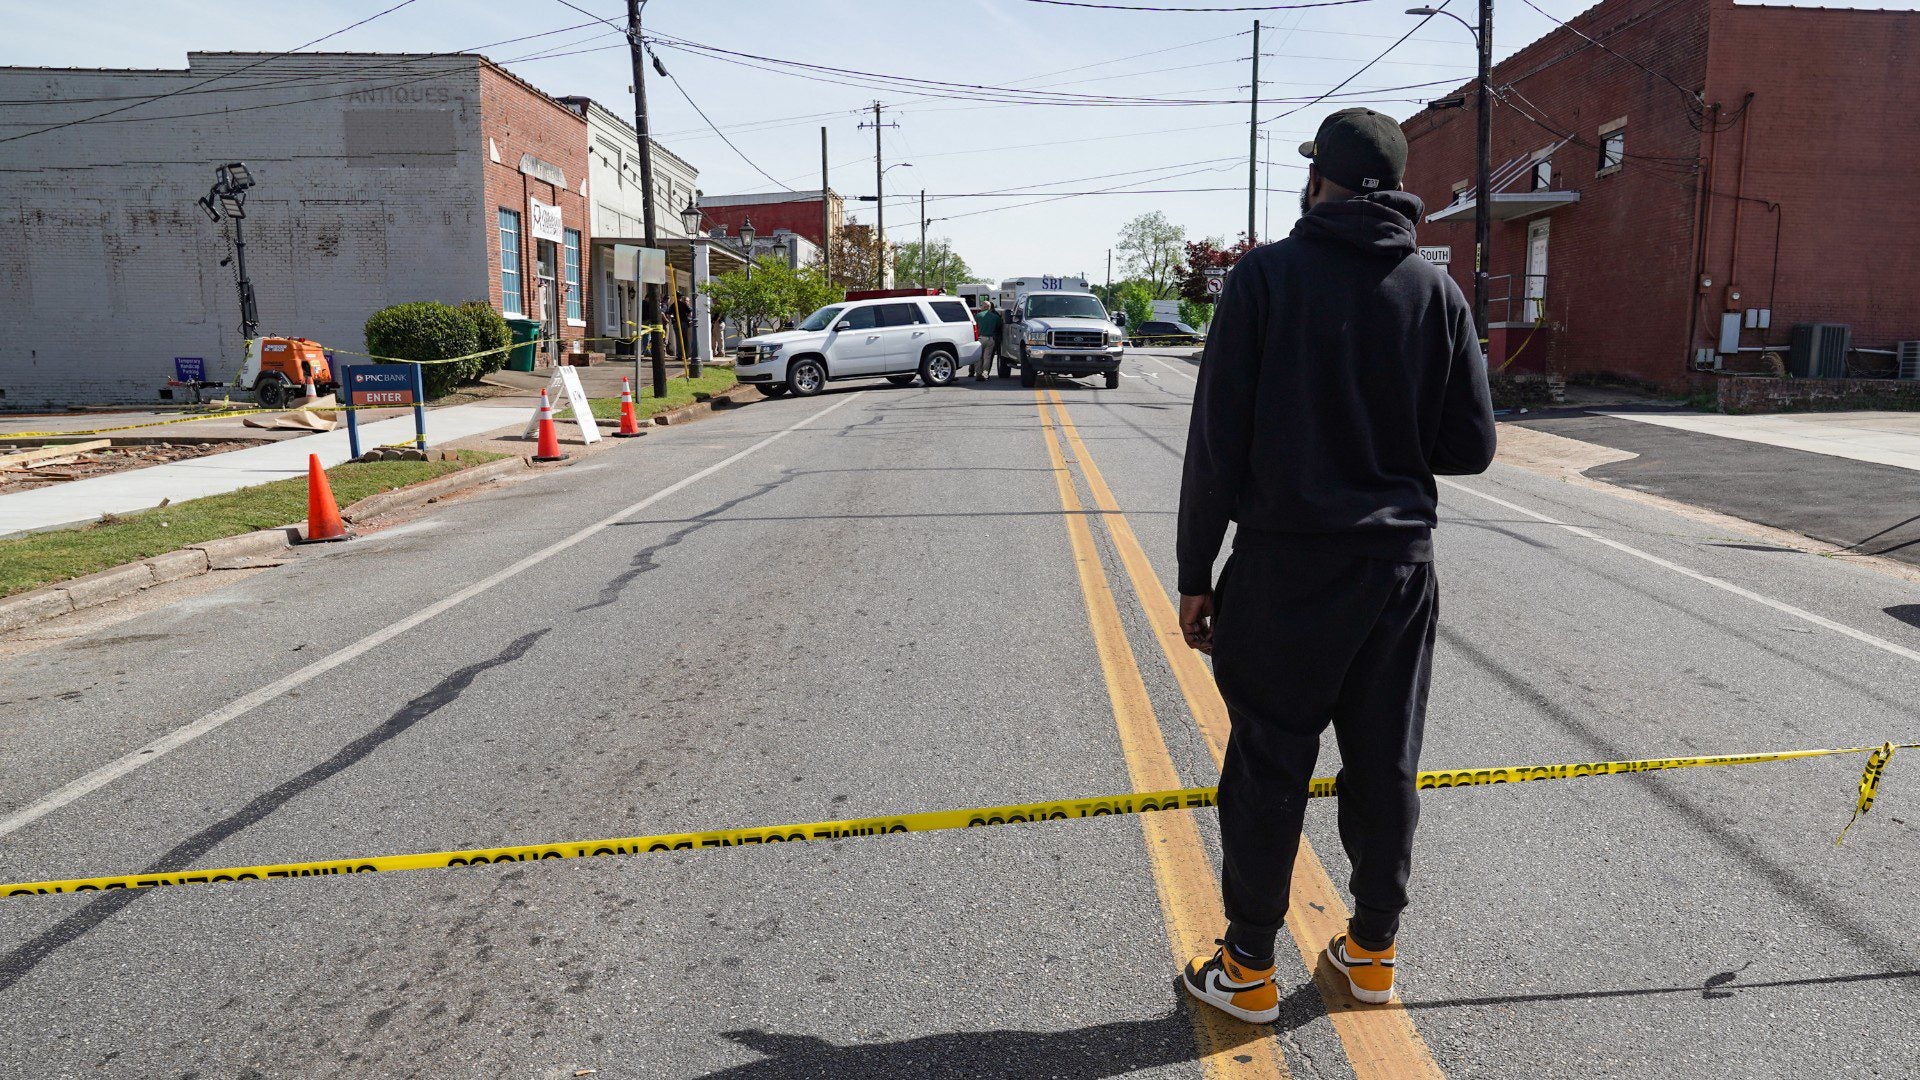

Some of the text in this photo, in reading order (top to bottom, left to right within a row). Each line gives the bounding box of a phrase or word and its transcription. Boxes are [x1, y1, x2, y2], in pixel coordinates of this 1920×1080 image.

[349, 87, 449, 103] ANTIQUES
[1420, 249, 1449, 261] SOUTH
[1042, 278, 1063, 290] SBI
[365, 374, 383, 382] PNC
[366, 392, 402, 402] ENTER
